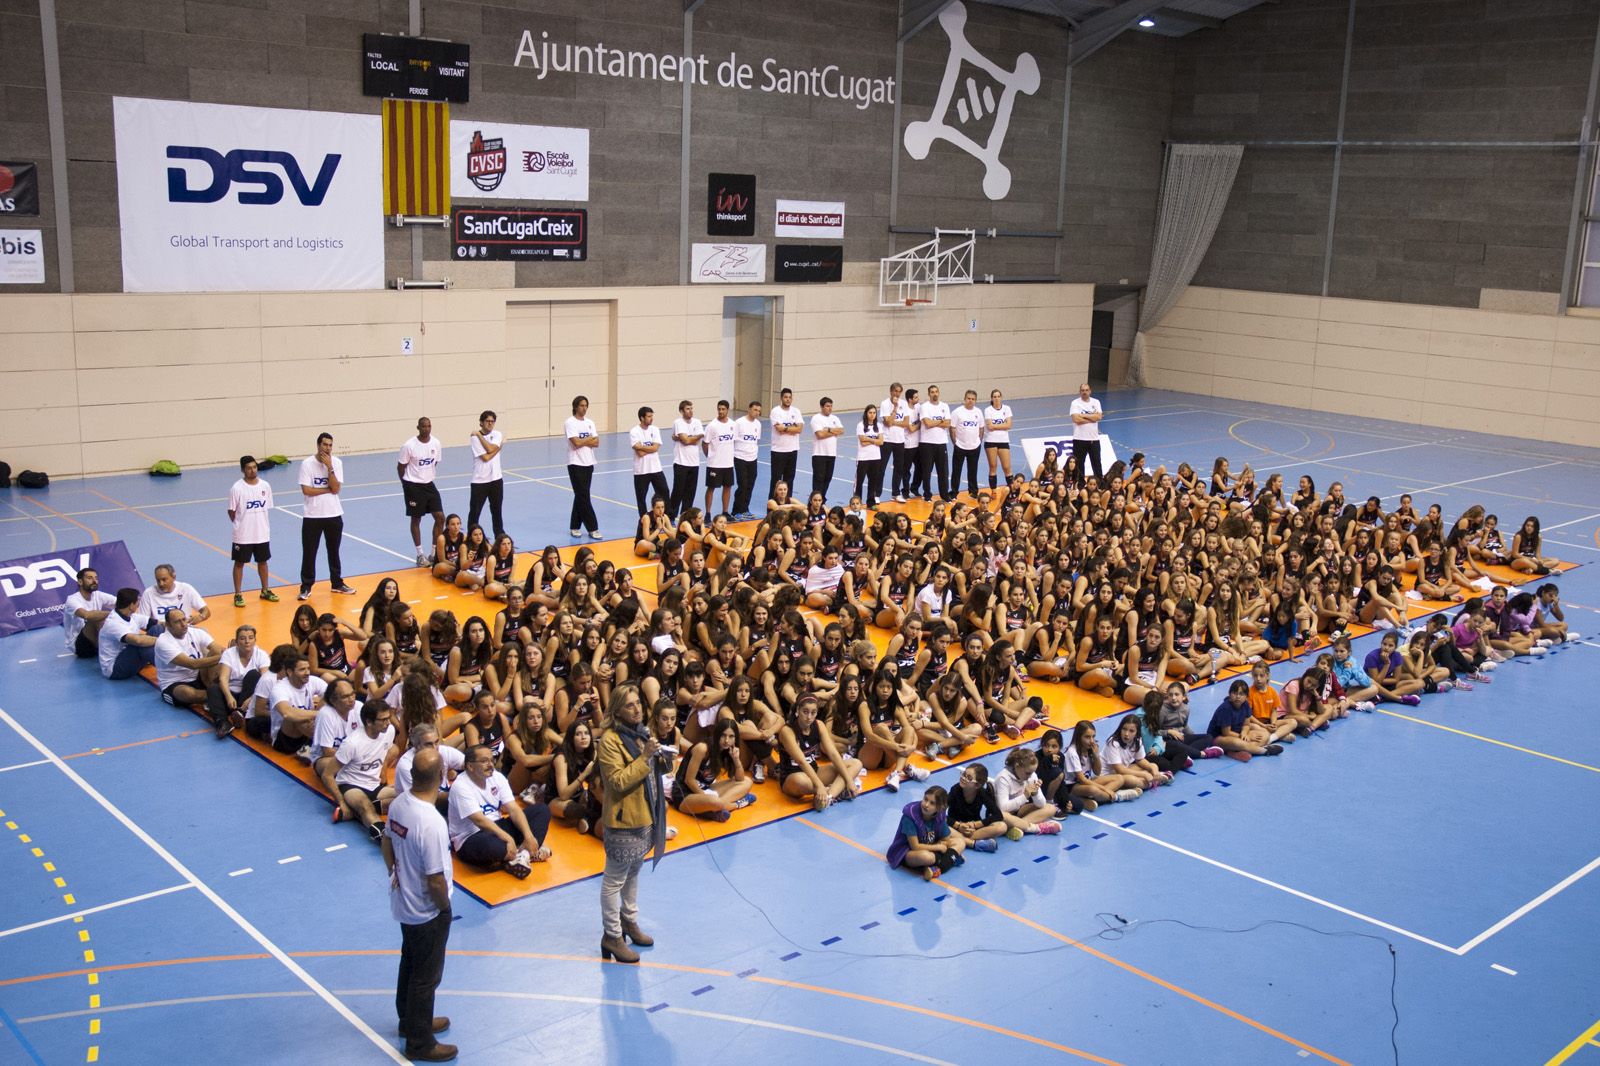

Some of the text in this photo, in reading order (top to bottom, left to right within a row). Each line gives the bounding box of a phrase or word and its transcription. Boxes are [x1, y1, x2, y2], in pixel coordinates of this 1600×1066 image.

[370, 60, 399, 72] LOCAL
[514, 29, 896, 110] Ajuntament de SantCugat
[438, 67, 466, 78] VISITANT
[546, 151, 569, 160] Escola
[470, 152, 503, 173] CVSC
[166, 145, 342, 207] DSV
[716, 212, 747, 222] thinksport
[779, 214, 785, 222] el
[800, 215, 808, 224] de
[808, 215, 823, 224] Sant
[823, 215, 841, 226] Cugat
[463, 215, 574, 240] SantCugatCreix
[0, 236, 36, 255] bis
[170, 235, 344, 252] Global Transport and Logistics
[404, 340, 410, 350] 2
[719, 434, 734, 442] DSV
[246, 500, 266, 510] DSV
[15, 607, 37, 618] Global
